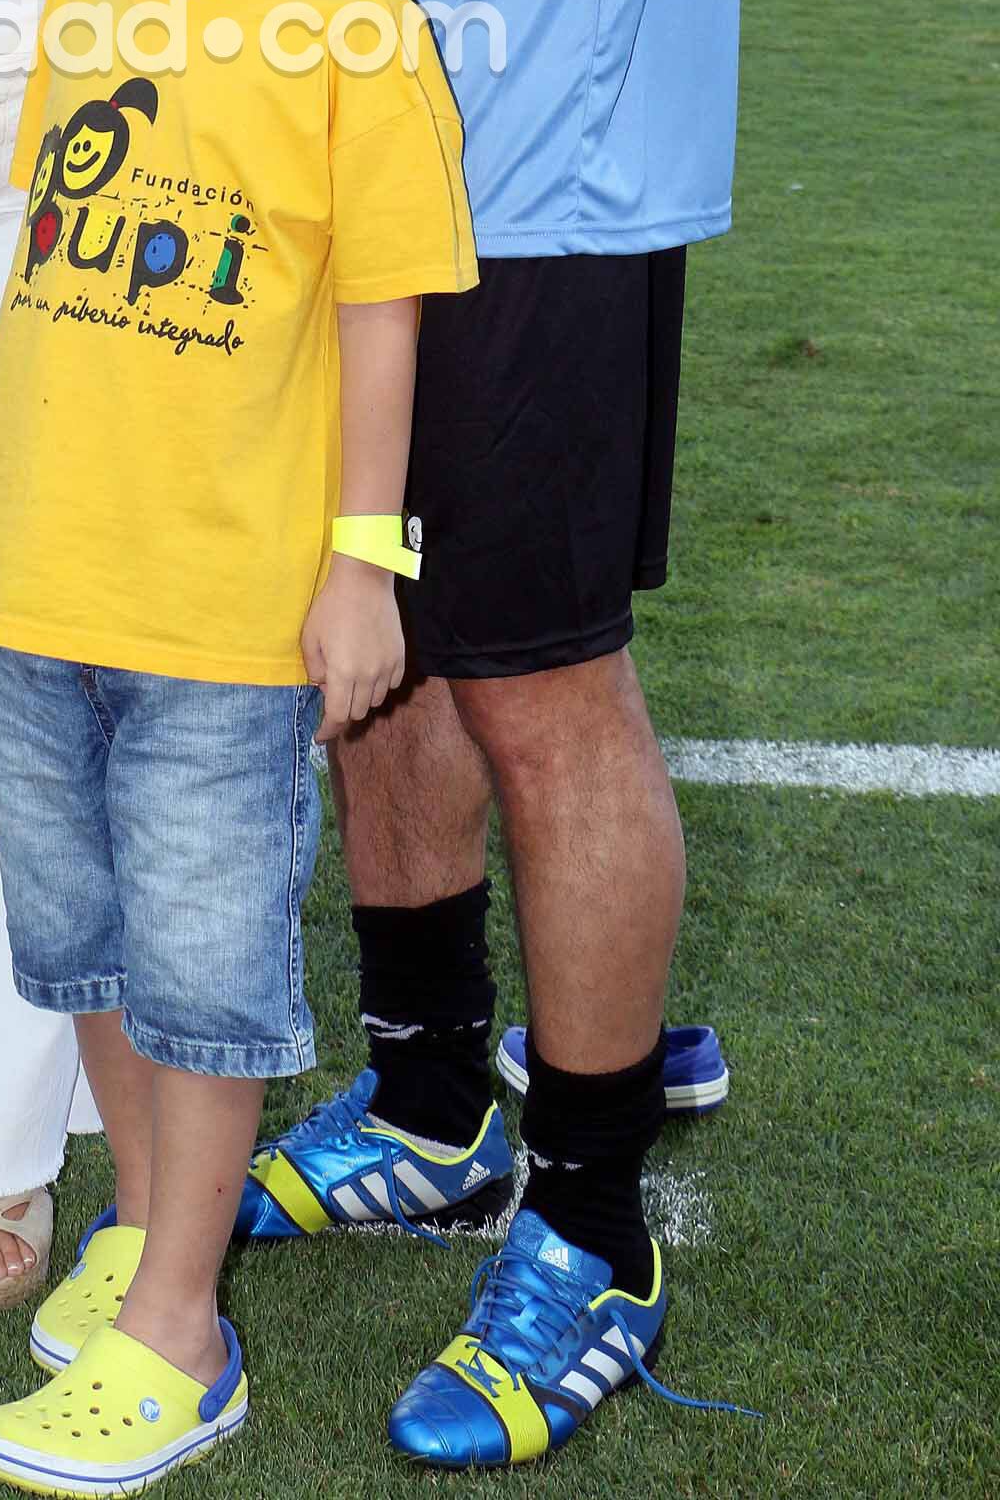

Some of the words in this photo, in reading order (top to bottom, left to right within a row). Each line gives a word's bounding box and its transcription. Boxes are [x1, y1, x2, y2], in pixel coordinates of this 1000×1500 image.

[131, 167, 255, 213] Fundación
[10, 289, 33, 312] por
[35, 298, 50, 311] un
[137, 315, 245, 356] integrado
[462, 1167, 491, 1191] adidas
